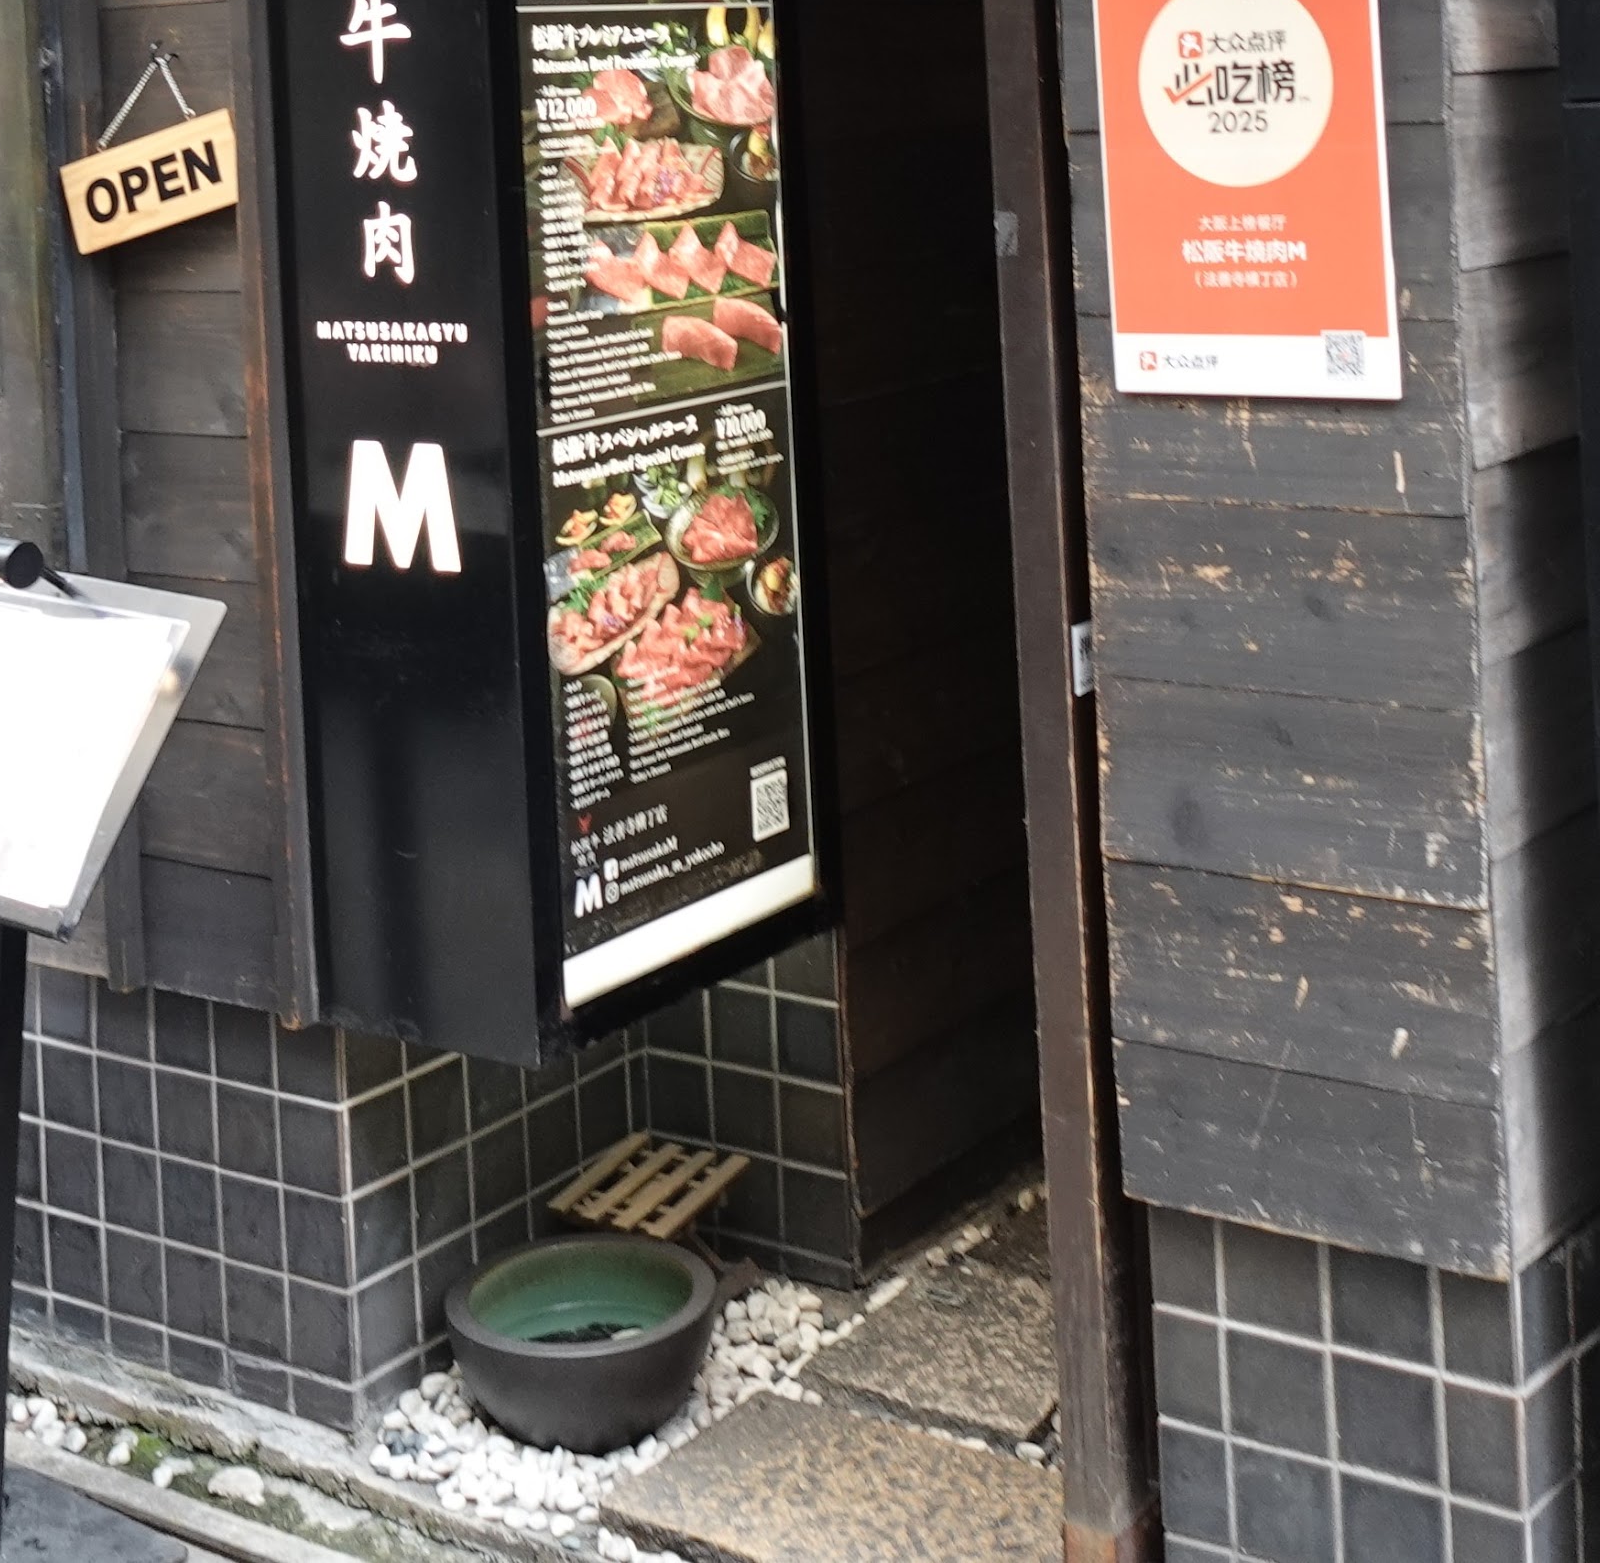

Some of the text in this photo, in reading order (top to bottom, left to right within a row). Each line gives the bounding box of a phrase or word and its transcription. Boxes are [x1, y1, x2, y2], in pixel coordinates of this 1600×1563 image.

[1206, 29, 1287, 54] 大众点评
[1208, 110, 1269, 134] 2025
[86, 139, 222, 224] OPEN
[316, 320, 468, 343] MATSUSAKAGYU
[347, 343, 438, 365] YAKINIKU
[345, 439, 462, 573] M
[574, 872, 603, 918] M
